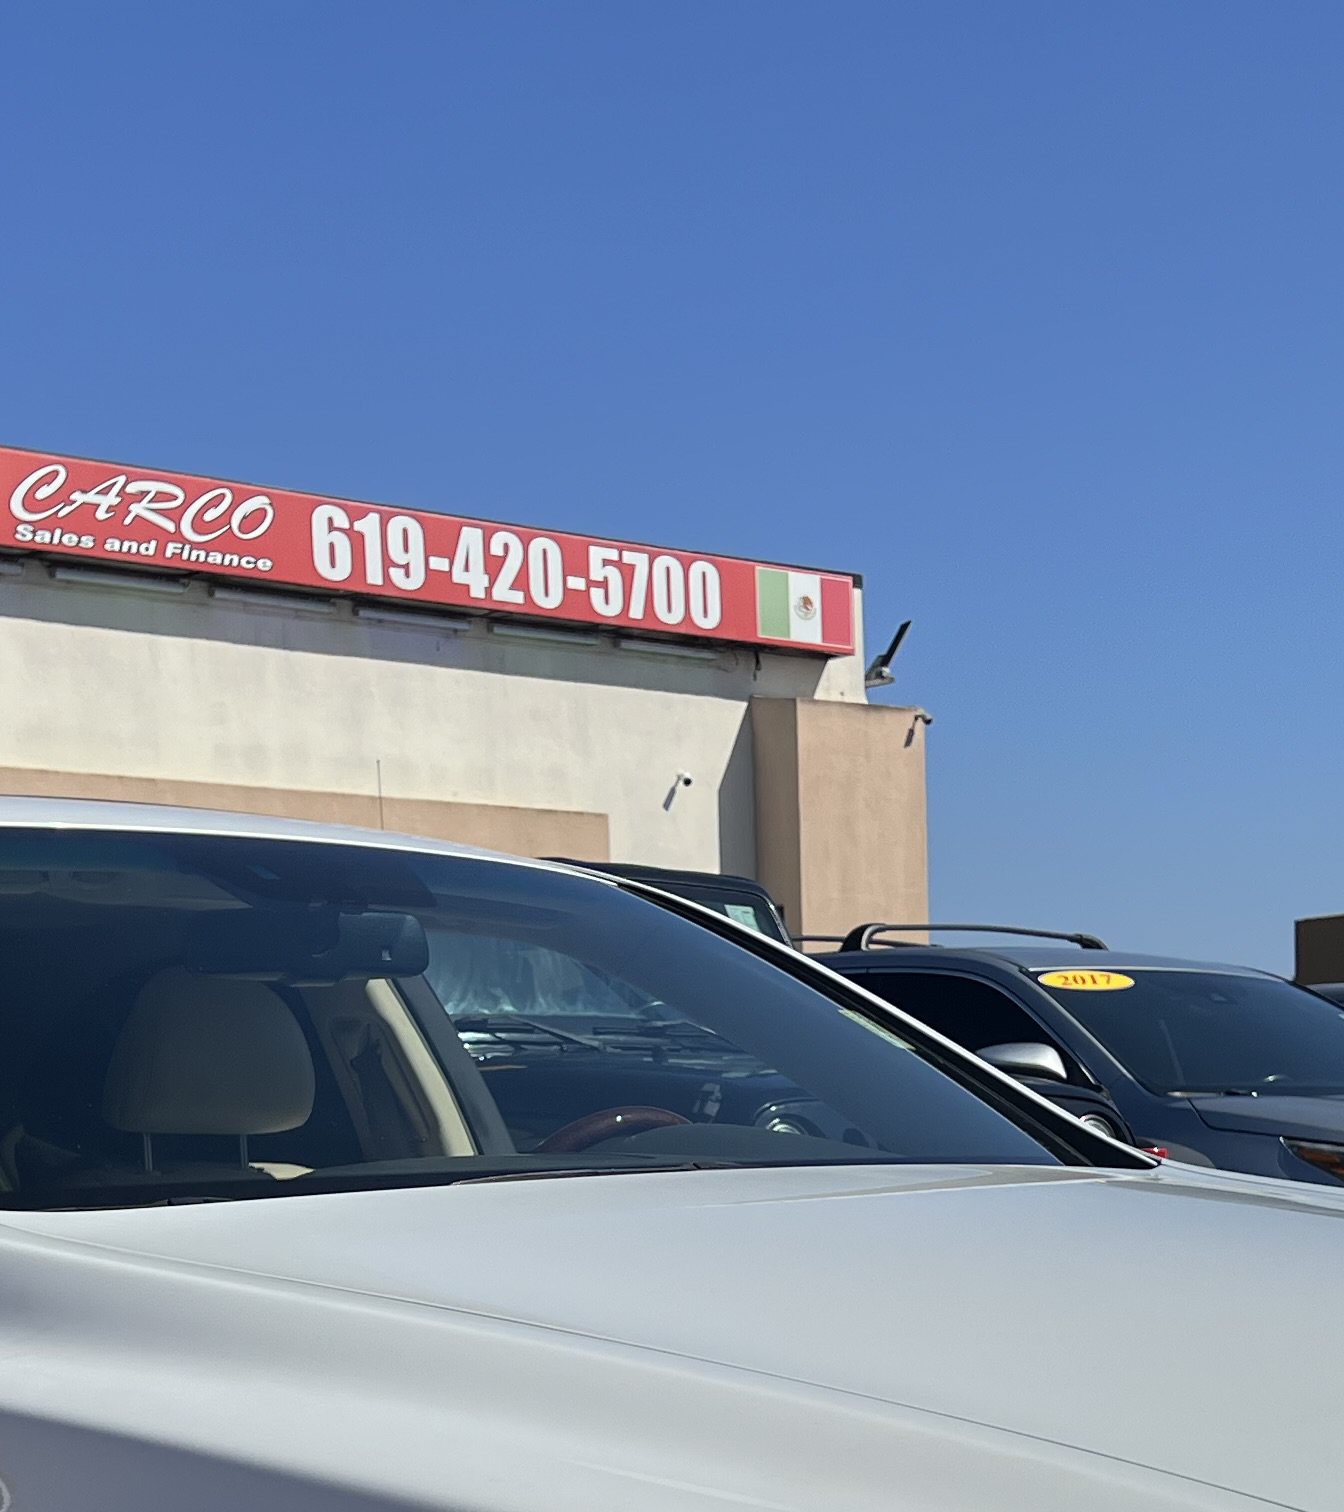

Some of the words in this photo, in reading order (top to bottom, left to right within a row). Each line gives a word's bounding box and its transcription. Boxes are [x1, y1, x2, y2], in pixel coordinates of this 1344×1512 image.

[9, 463, 276, 543] CARCO
[14, 523, 97, 549] Sales
[103, 537, 158, 557] and
[164, 541, 274, 572] Finance
[308, 503, 723, 631] 619-420-5700
[1057, 972, 1113, 987] 2017
